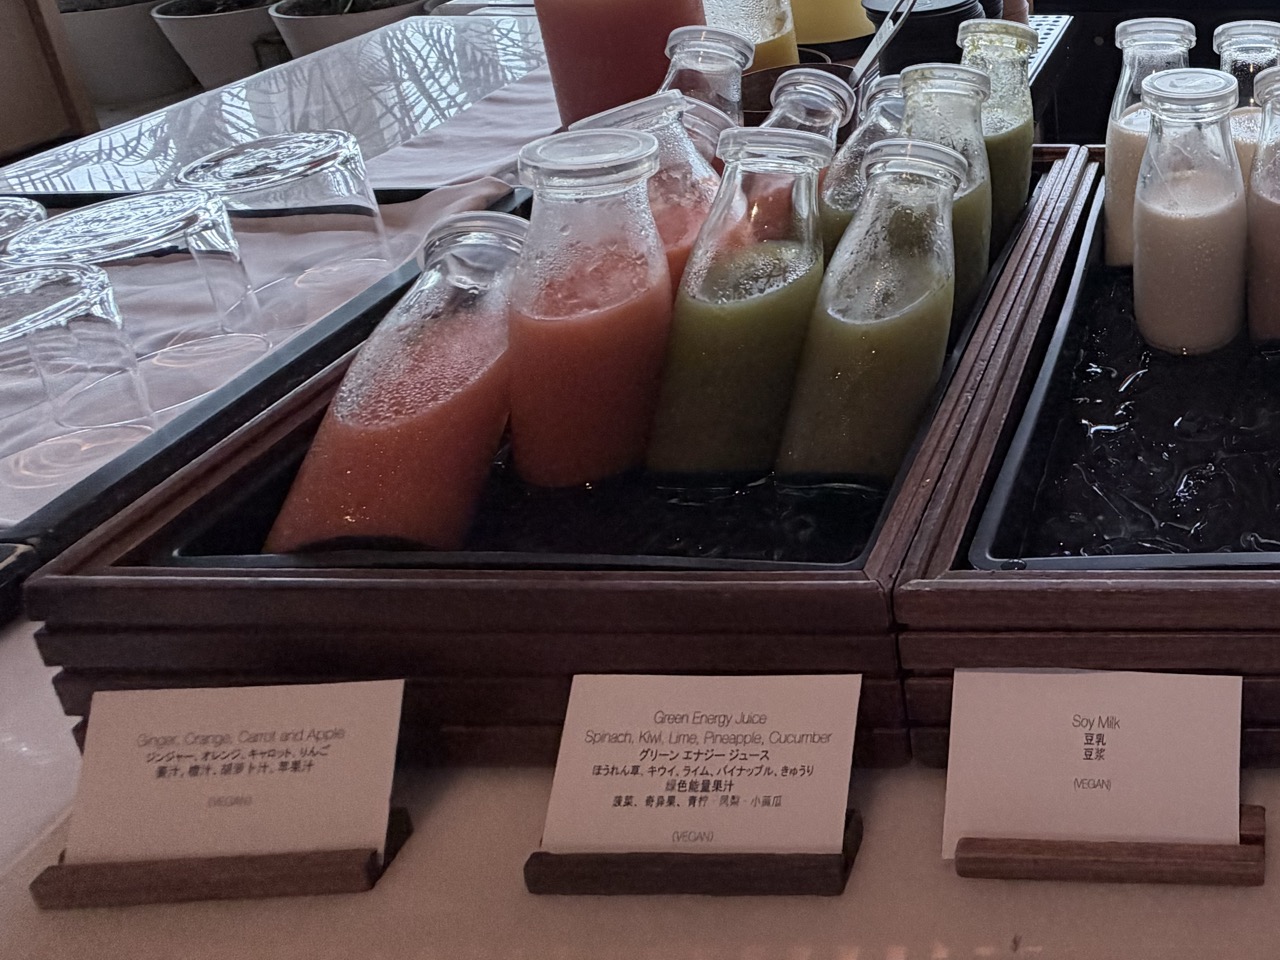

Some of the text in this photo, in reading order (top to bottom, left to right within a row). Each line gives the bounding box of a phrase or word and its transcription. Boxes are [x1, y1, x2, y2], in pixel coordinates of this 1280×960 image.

[653, 710, 767, 727] Green Energy Juice
[1071, 714, 1121, 731] Soy Milk
[279, 730, 303, 742] and
[584, 730, 634, 746] Spinach,
[668, 731, 699, 746] Lime,
[704, 730, 765, 746] Pineapple,
[769, 730, 833, 744] Cucumber
[1083, 733, 1107, 746] 豆乳
[639, 749, 770, 761] グリーン エナジー ジュース
[1073, 777, 1112, 793] (VEGAN)
[672, 830, 714, 843] (VEGAN)
